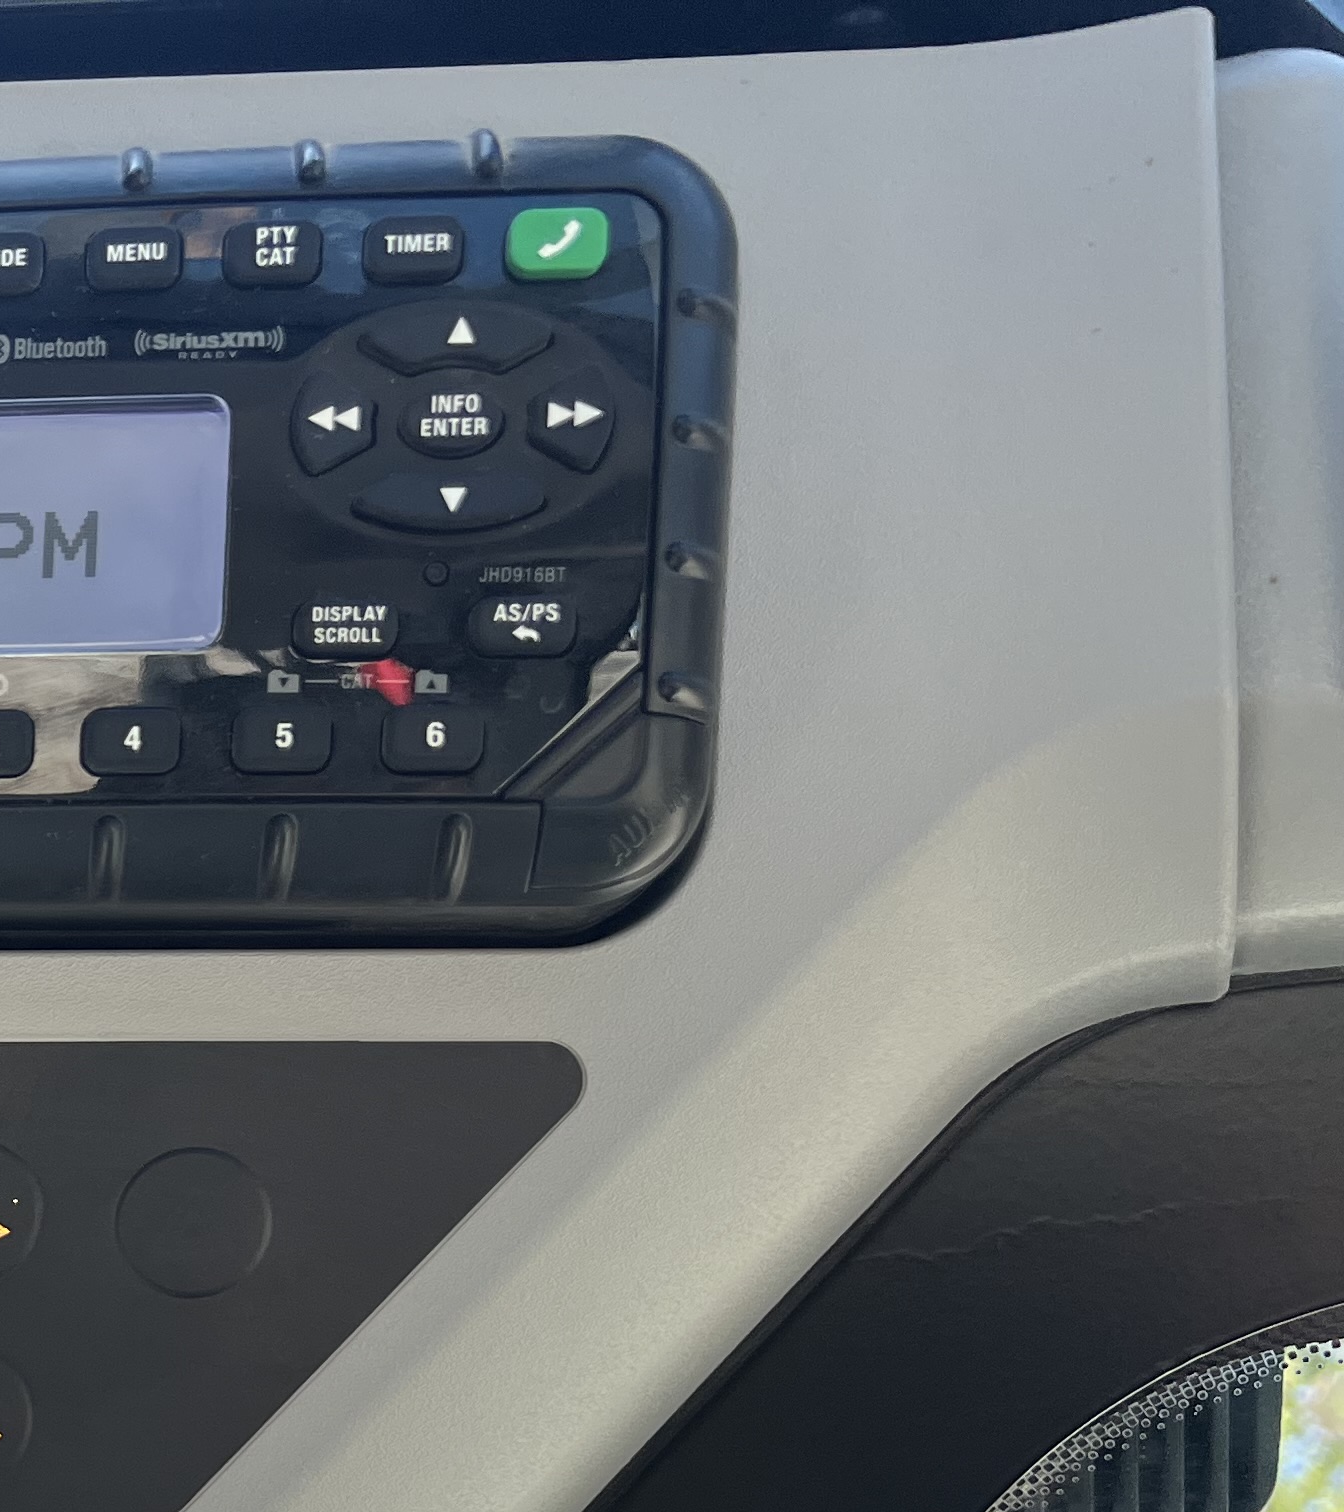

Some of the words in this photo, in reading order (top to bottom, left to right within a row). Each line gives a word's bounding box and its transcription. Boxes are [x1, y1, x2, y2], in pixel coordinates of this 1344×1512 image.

[255, 225, 299, 246] PTY
[384, 231, 451, 254] TIMER
[106, 241, 168, 264] MENU
[255, 246, 298, 268] CAT
[14, 335, 109, 360] Bluetooth
[178, 350, 239, 360] READY
[430, 393, 482, 415] INFO
[420, 416, 491, 438] ENTER
[479, 566, 567, 583] JHD916BT
[311, 604, 387, 624] DISPLAY
[493, 603, 561, 623] AS/PS
[314, 625, 382, 645] SCROLL
[123, 724, 143, 752] 4
[275, 722, 295, 750] 5
[426, 721, 447, 749] 6
